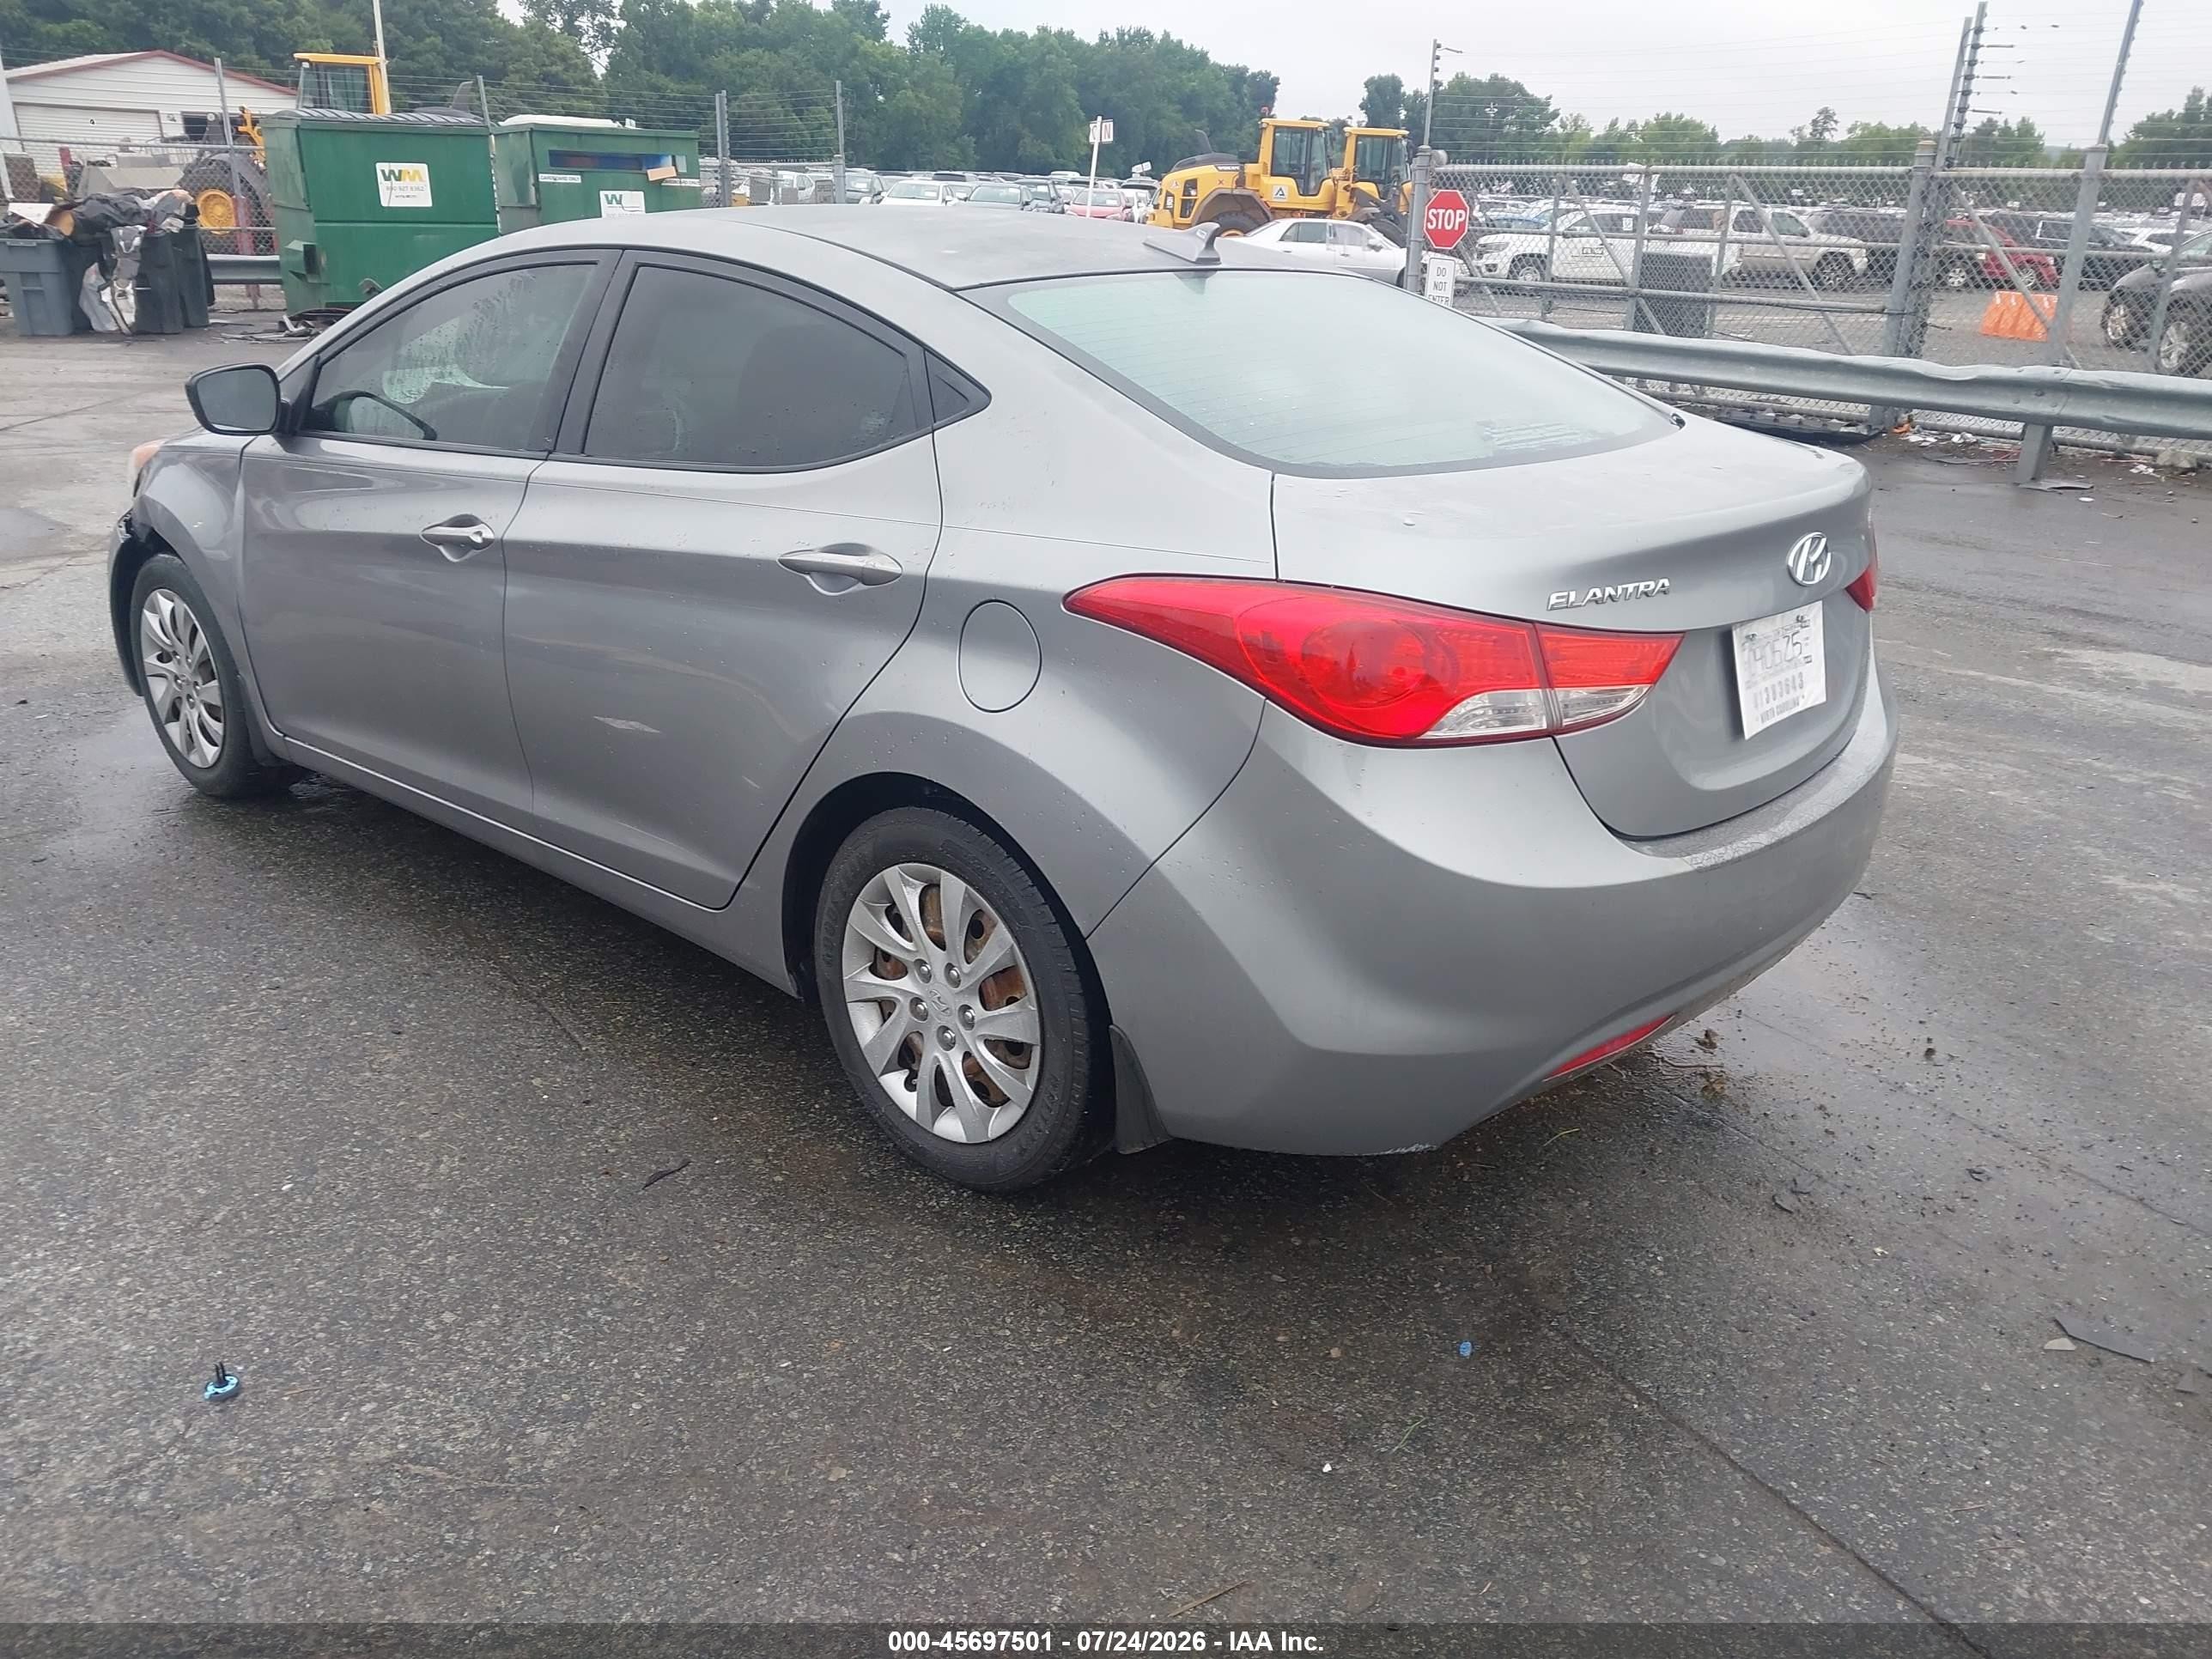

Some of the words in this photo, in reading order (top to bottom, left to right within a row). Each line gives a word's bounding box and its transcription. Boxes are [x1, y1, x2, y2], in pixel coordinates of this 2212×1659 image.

[380, 169, 423, 182] WM
[1427, 209, 1466, 231] STOP
[1437, 266, 1447, 276] DO
[1432, 281, 1448, 291] NOT
[1547, 578, 1670, 611] ELANTRA
